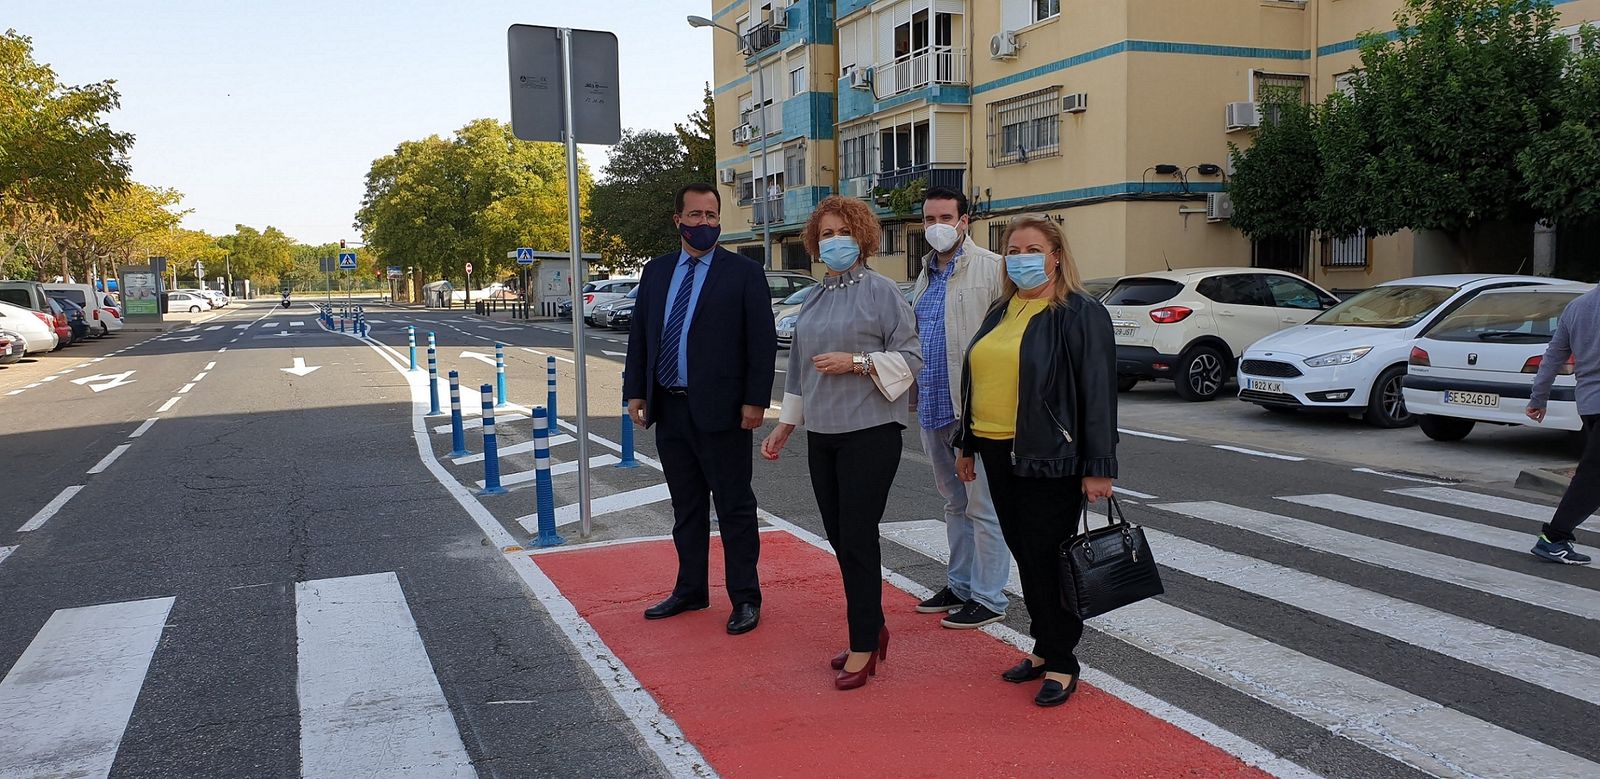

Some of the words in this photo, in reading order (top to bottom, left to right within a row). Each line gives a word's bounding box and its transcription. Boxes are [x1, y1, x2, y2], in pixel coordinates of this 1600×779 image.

[1252, 378, 1266, 390] 1822
[1268, 382, 1281, 392] KJK
[1448, 391, 1459, 402] SE
[1460, 393, 1483, 405] 5246
[1484, 395, 1497, 406] DJ
